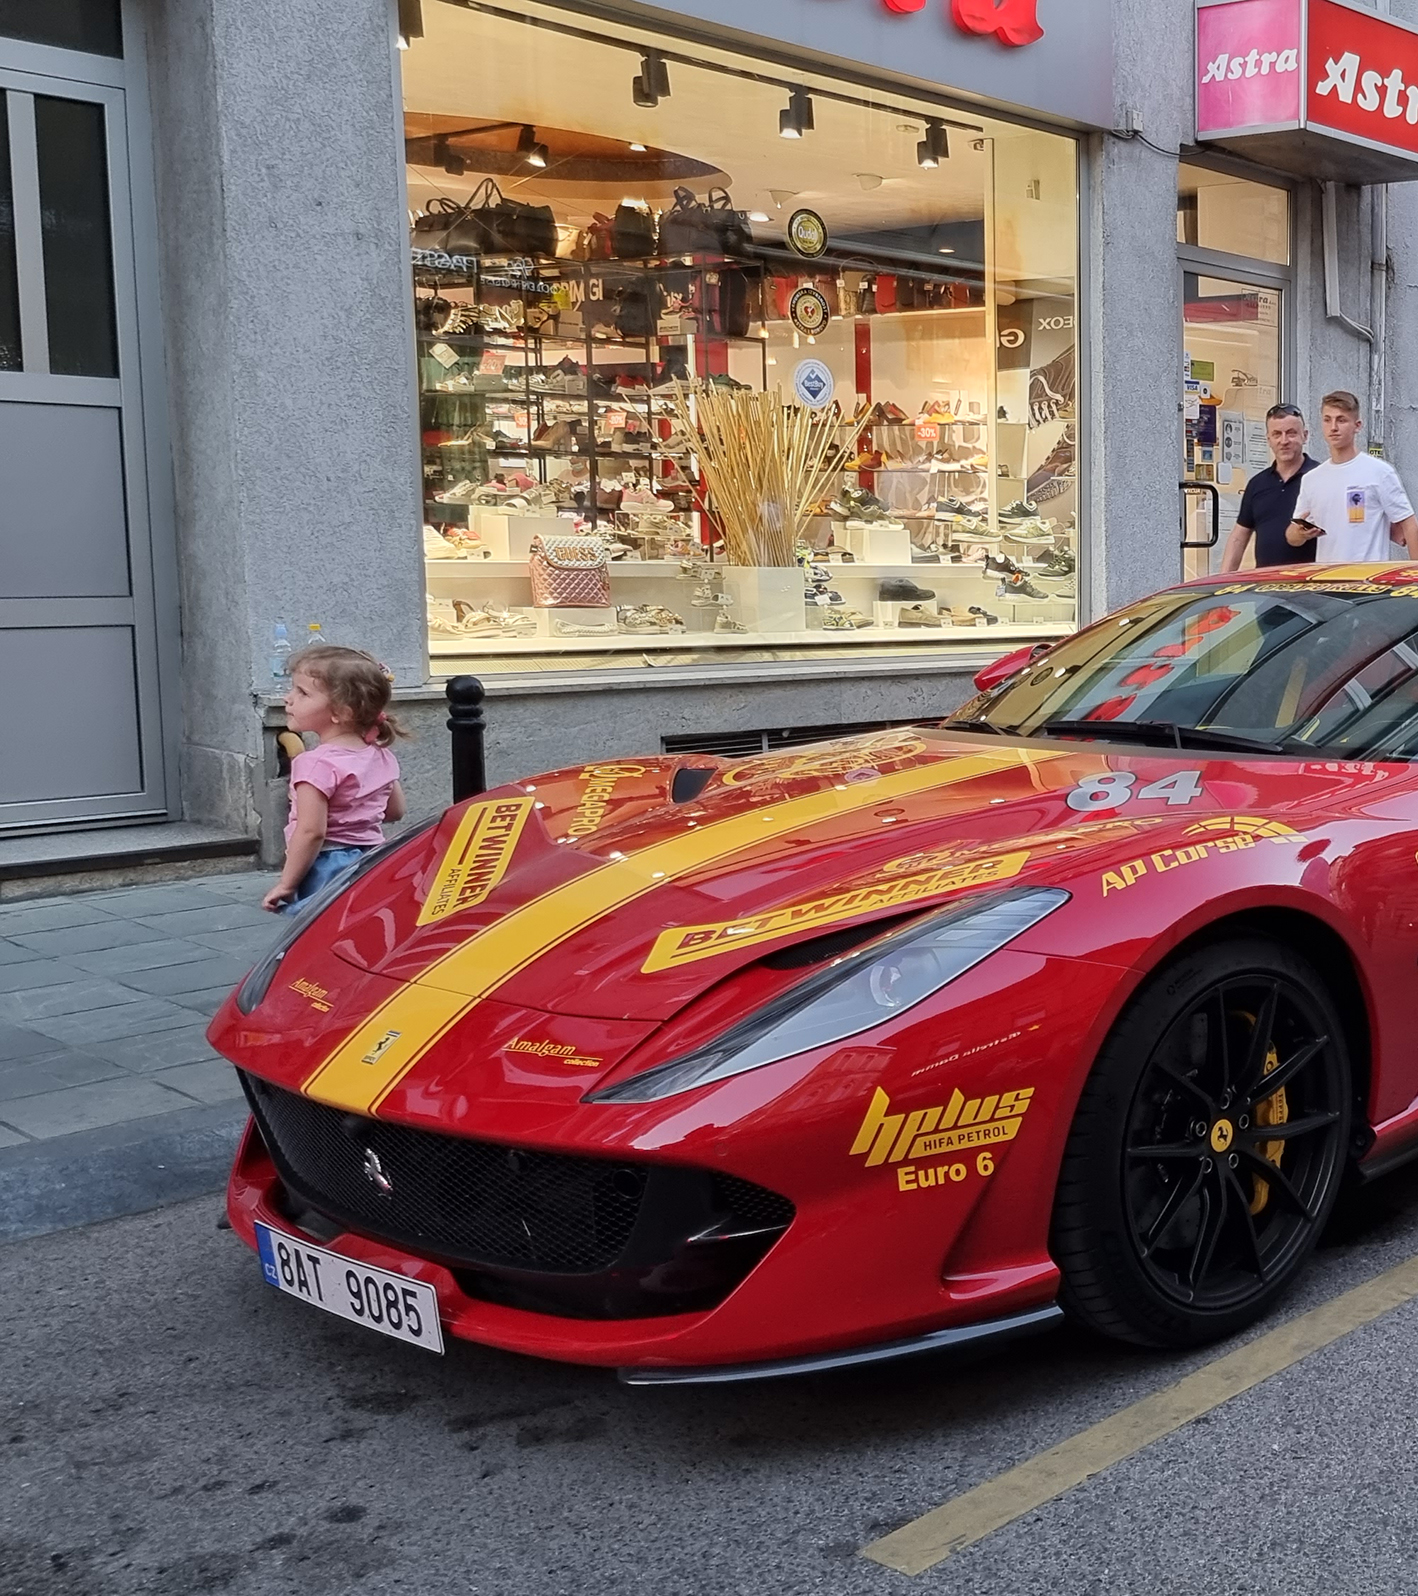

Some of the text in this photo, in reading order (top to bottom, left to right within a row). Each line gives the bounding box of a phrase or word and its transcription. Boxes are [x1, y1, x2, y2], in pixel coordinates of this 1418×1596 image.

[1201, 48, 1298, 84] Astra
[1187, 383, 1199, 391] VISA
[917, 430, 937, 438] -30%
[556, 547, 598, 562] GUESS
[1065, 771, 1203, 812] 84
[453, 803, 523, 909] BETWINNER
[1101, 834, 1256, 897] AP Corse
[430, 868, 462, 916] AFFILIATES
[677, 859, 1005, 951] BETWINNER
[868, 872, 999, 908] AFFILIATES
[505, 1036, 577, 1057] Amalgam
[563, 1058, 600, 1068] collection
[848, 1086, 1036, 1167] hplus
[923, 1125, 1009, 1152] HIFA PETROL
[897, 1152, 995, 1192] Euro 6
[264, 1263, 278, 1280] CZ
[277, 1241, 423, 1338] 8AT 9085
